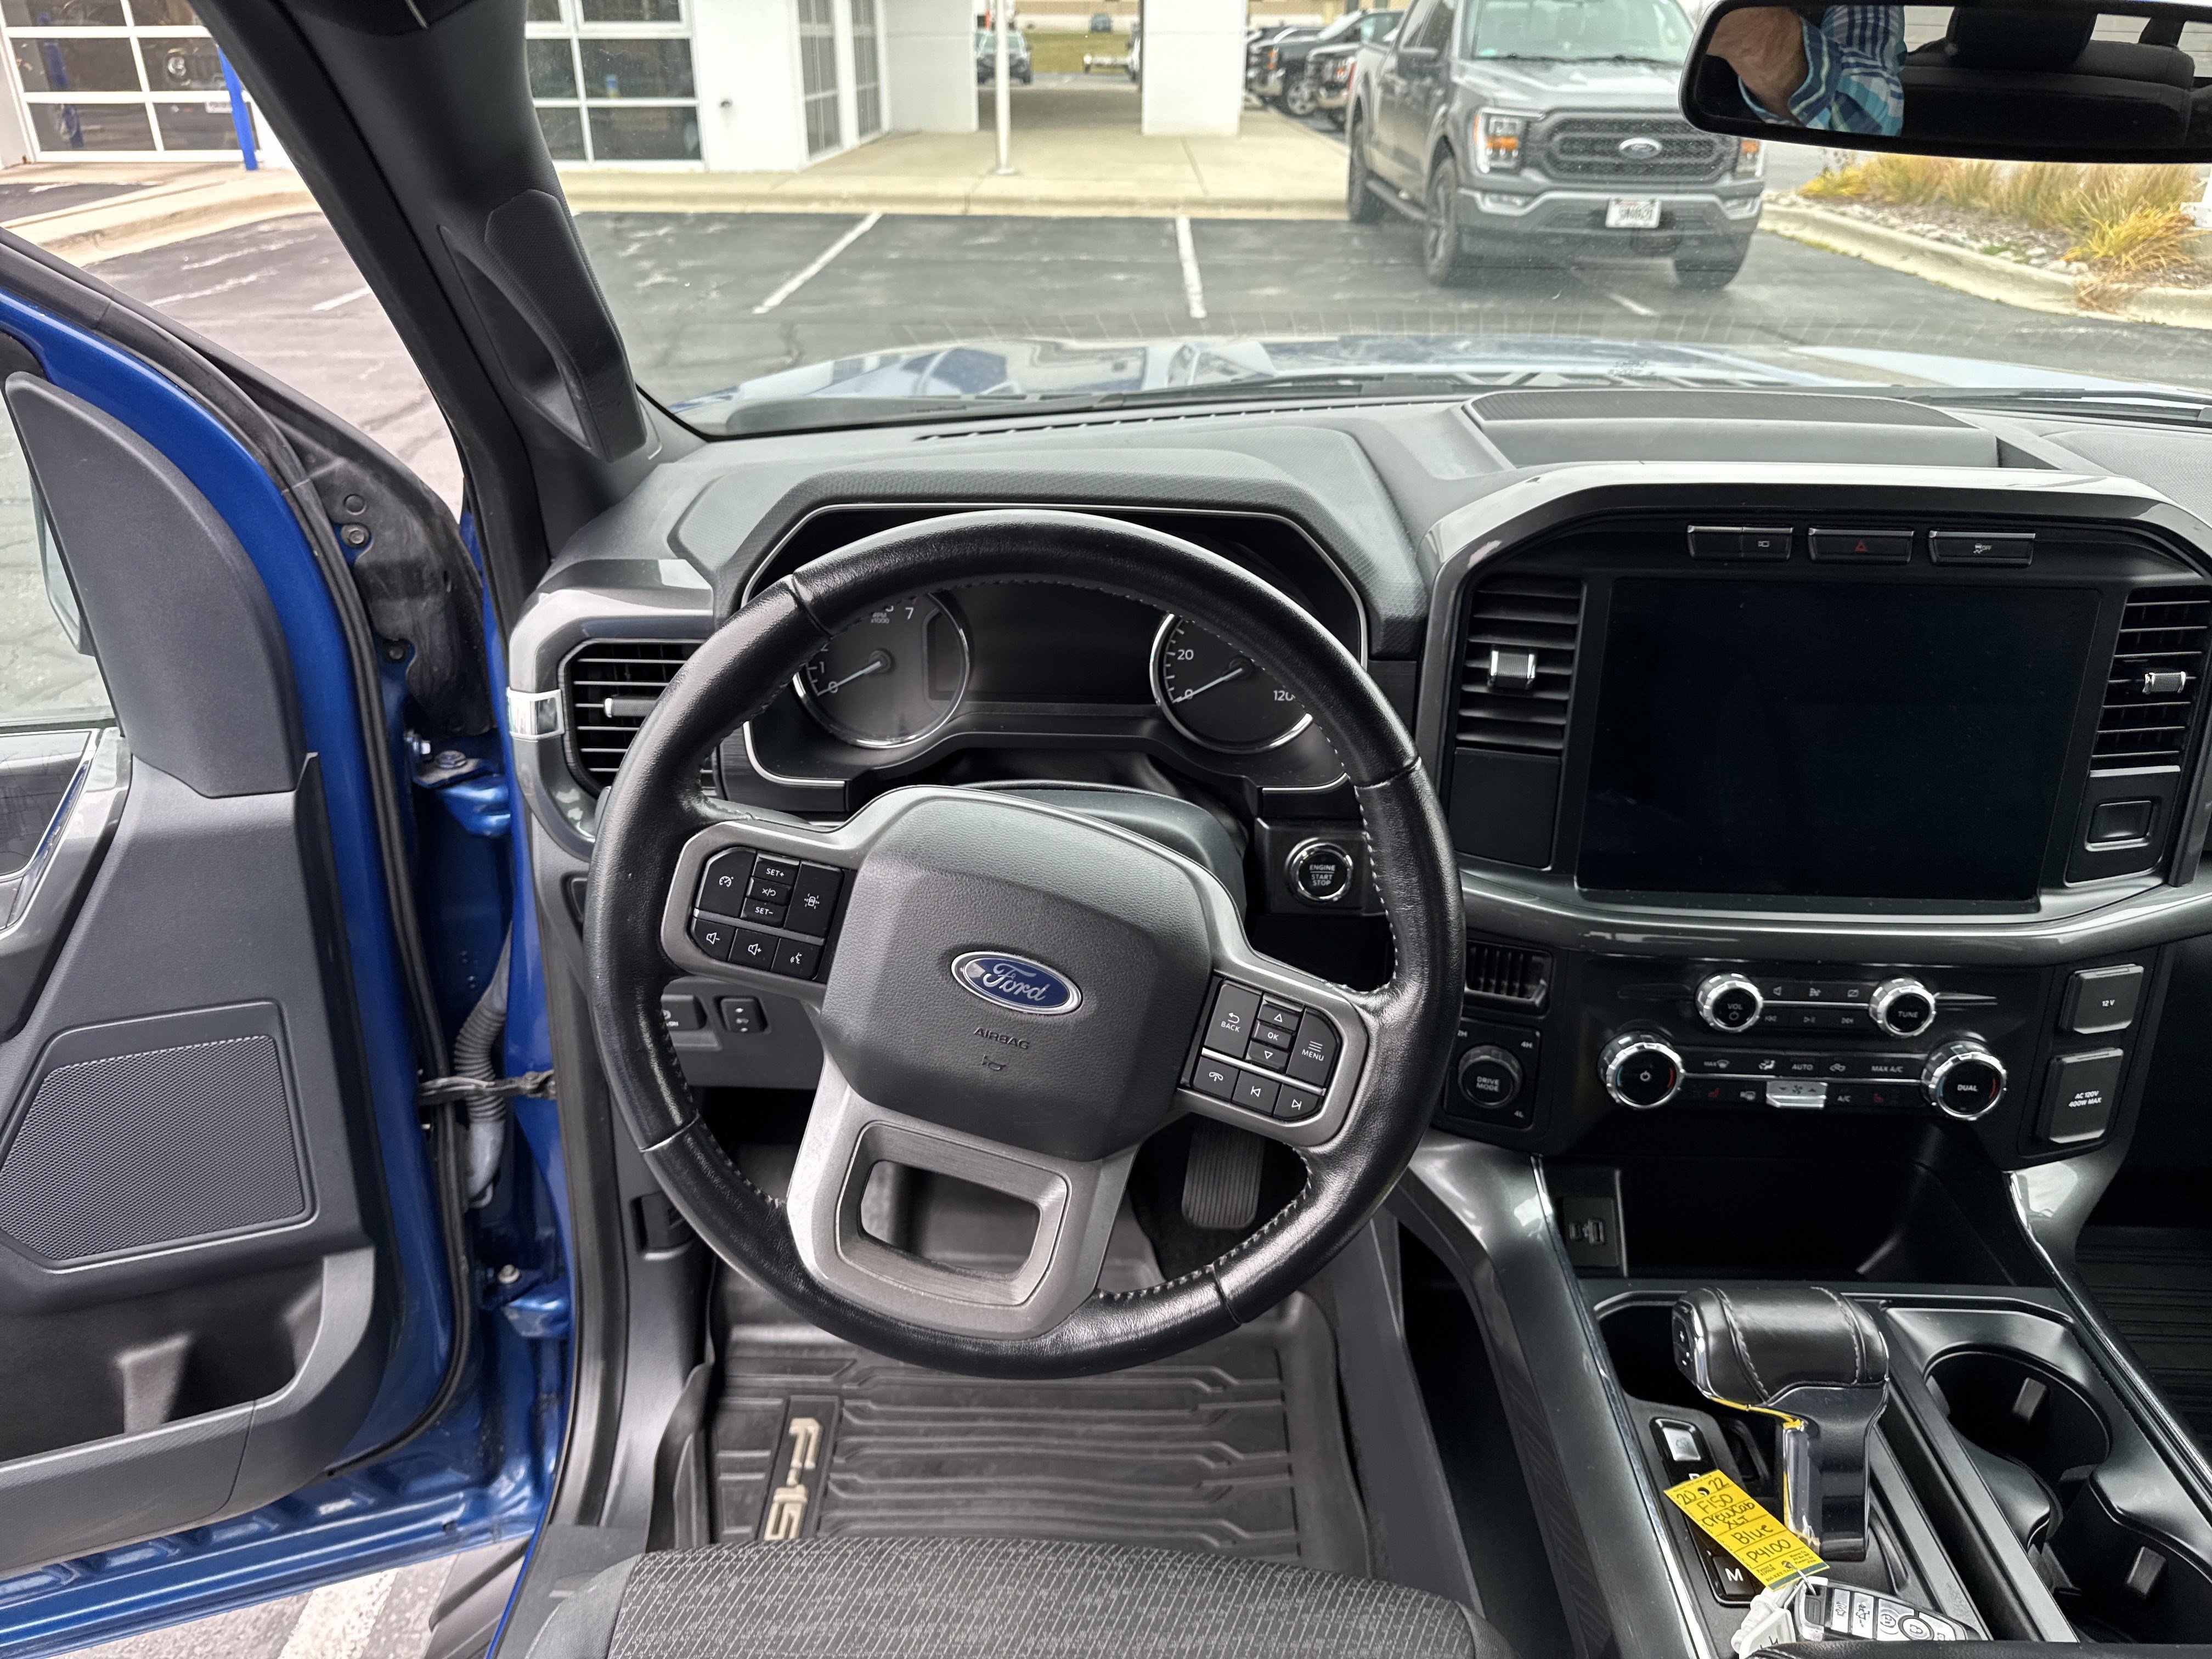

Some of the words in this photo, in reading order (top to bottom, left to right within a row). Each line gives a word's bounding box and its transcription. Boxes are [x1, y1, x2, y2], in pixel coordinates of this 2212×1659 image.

[905, 607, 913, 620] 7
[1177, 649, 1194, 661] 20
[765, 868, 785, 877] SET+
[983, 963, 1051, 1001] Ford
[1221, 1021, 1241, 1033] BACK
[974, 1027, 1030, 1049] AIRBAG
[1267, 1032, 1279, 1041] OK
[1301, 1048, 1324, 1062] MENU
[1476, 1076, 1500, 1085] DRIVE
[1476, 1082, 1499, 1092] MODE
[1957, 1084, 1978, 1092] DUAL
[764, 1417, 822, 1541] F-15
[1676, 1490, 1697, 1505] 20
[1708, 1476, 1730, 1491] 22
[1696, 1493, 1734, 1514] F150
[1726, 1515, 1750, 1530] XLT
[1731, 1524, 1774, 1545] Blue
[1746, 1539, 1792, 1563] P4100
[1724, 1568, 1744, 1582] M
